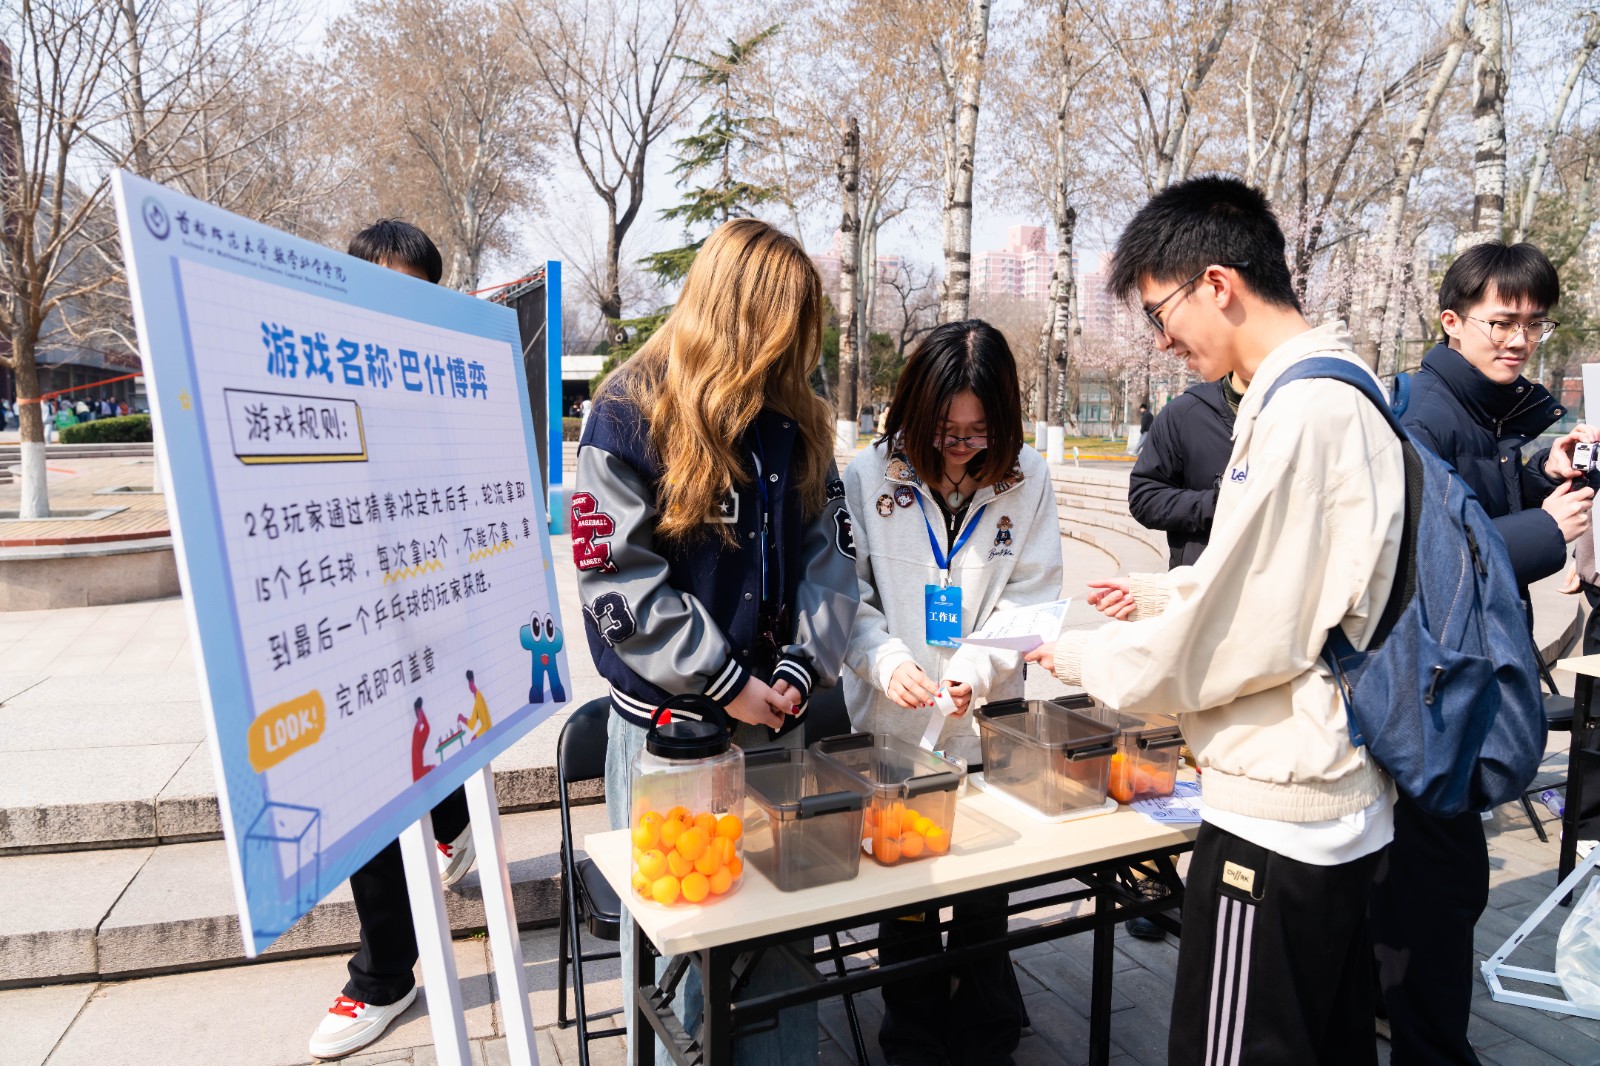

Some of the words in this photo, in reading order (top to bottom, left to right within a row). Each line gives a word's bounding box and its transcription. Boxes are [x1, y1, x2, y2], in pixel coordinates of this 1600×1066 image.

[244, 402, 348, 442] 游戏规则：
[1231, 468, 1247, 481] Le
[577, 519, 608, 527] BASEBALL
[268, 569, 492, 671] 到最后一个乒乓球的玩家获胜。
[929, 611, 958, 624] 工作证
[336, 644, 436, 719] 完成即可盖章
[263, 705, 319, 753] LOOK!
